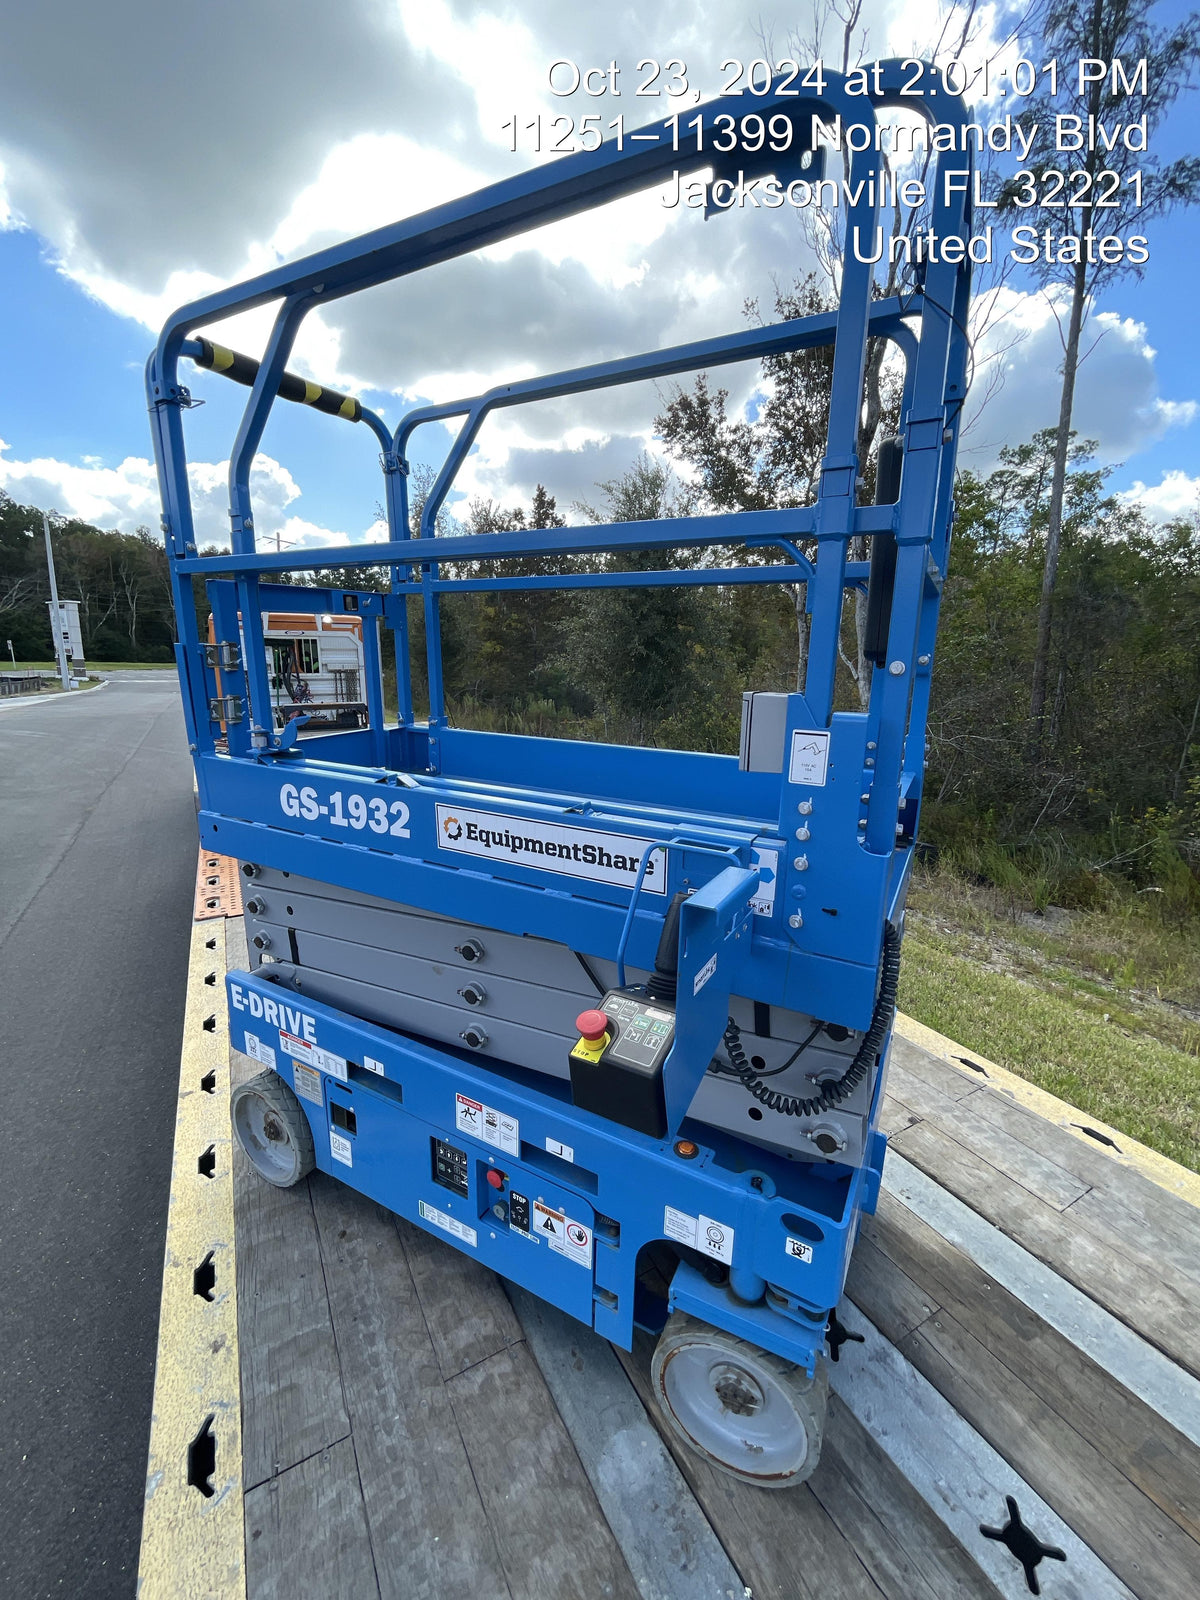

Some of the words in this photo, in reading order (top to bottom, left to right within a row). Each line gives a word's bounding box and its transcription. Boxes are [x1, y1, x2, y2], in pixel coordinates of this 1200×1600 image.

[280, 783, 411, 839] GS-1932
[466, 822, 655, 876] EquipmentShare
[230, 982, 318, 1044] E-DRIVE
[512, 1192, 527, 1204] STOP
